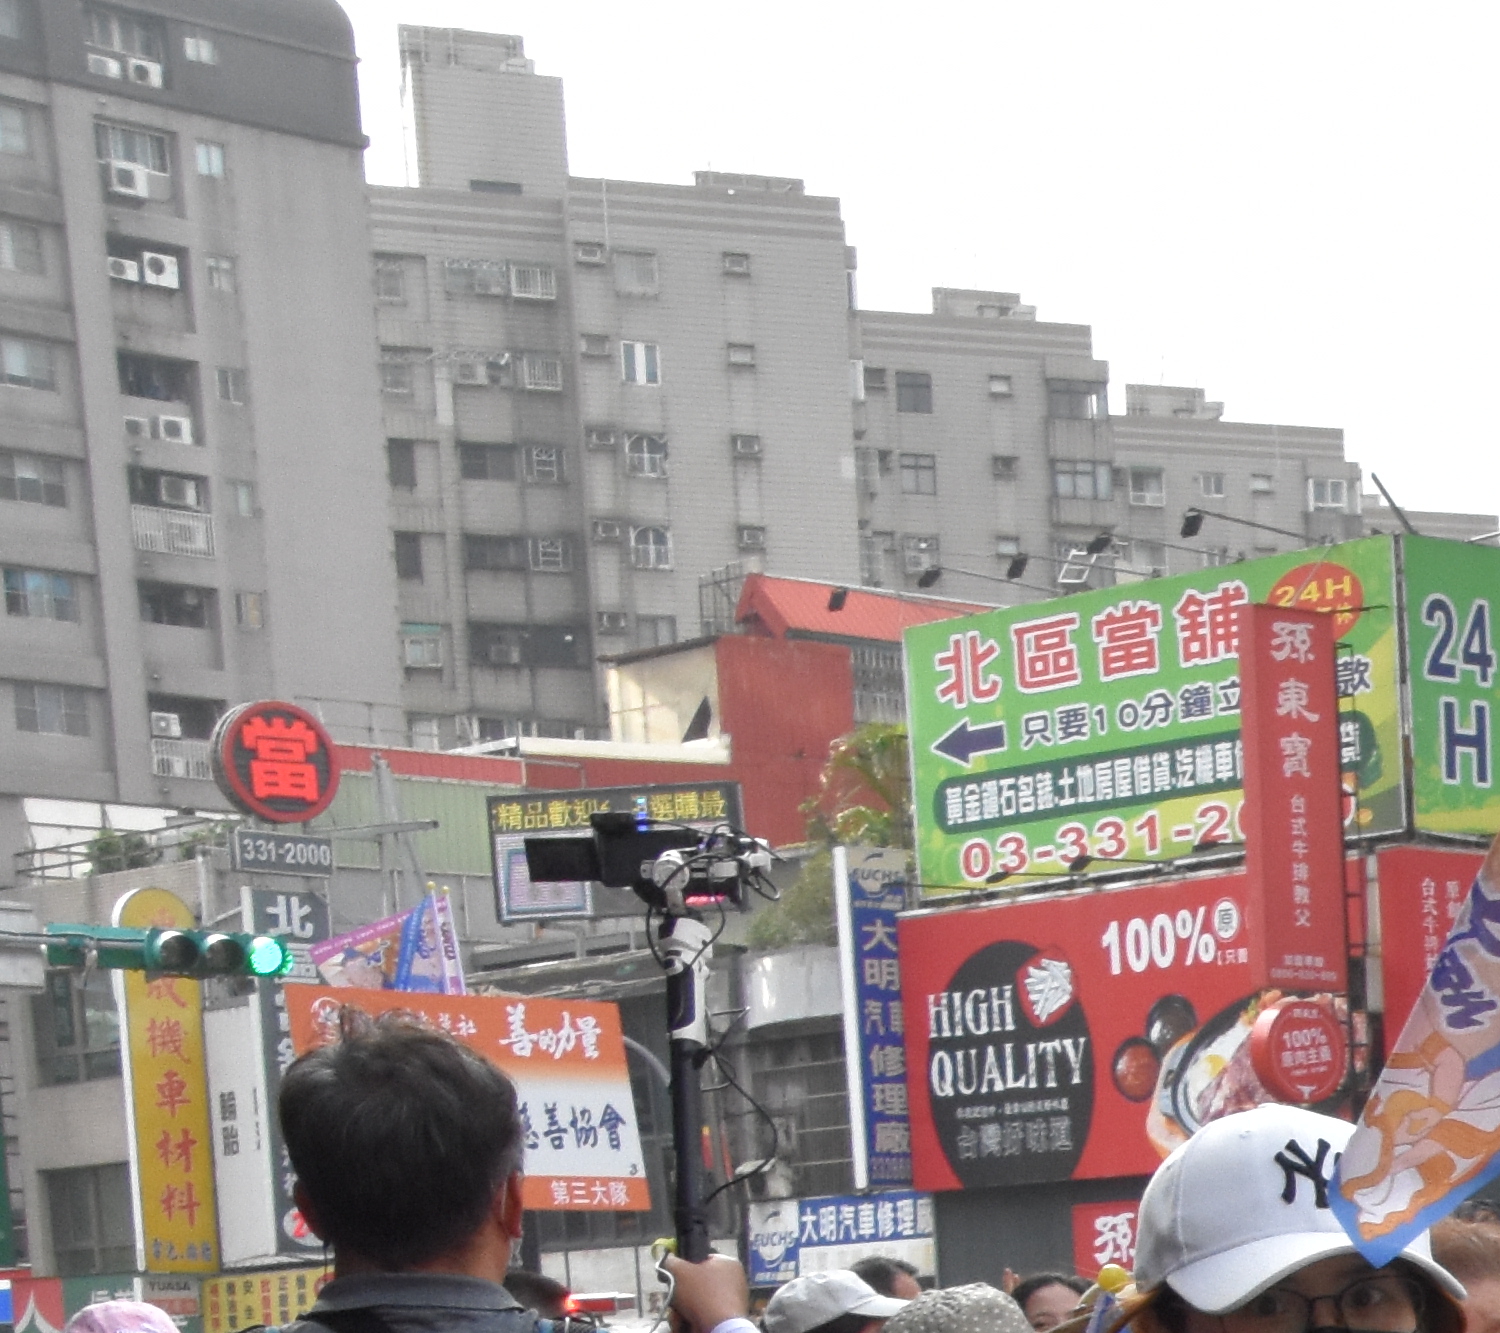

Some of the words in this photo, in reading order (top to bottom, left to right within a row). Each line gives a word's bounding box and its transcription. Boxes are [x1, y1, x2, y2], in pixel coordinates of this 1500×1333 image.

[936, 580, 1249, 707] 北區當舖
[1422, 593, 1497, 688] 24
[241, 716, 319, 802] 當
[1439, 697, 1492, 788] H
[242, 838, 332, 870] 331-2000
[1102, 904, 1217, 977] 100%
[500, 1001, 601, 1059] 善的力量
[927, 984, 1015, 1040] HIGH
[930, 1036, 1088, 1097] QUALITY
[551, 1180, 630, 1206] 第三大隊
[752, 1229, 797, 1249] FUCHS
